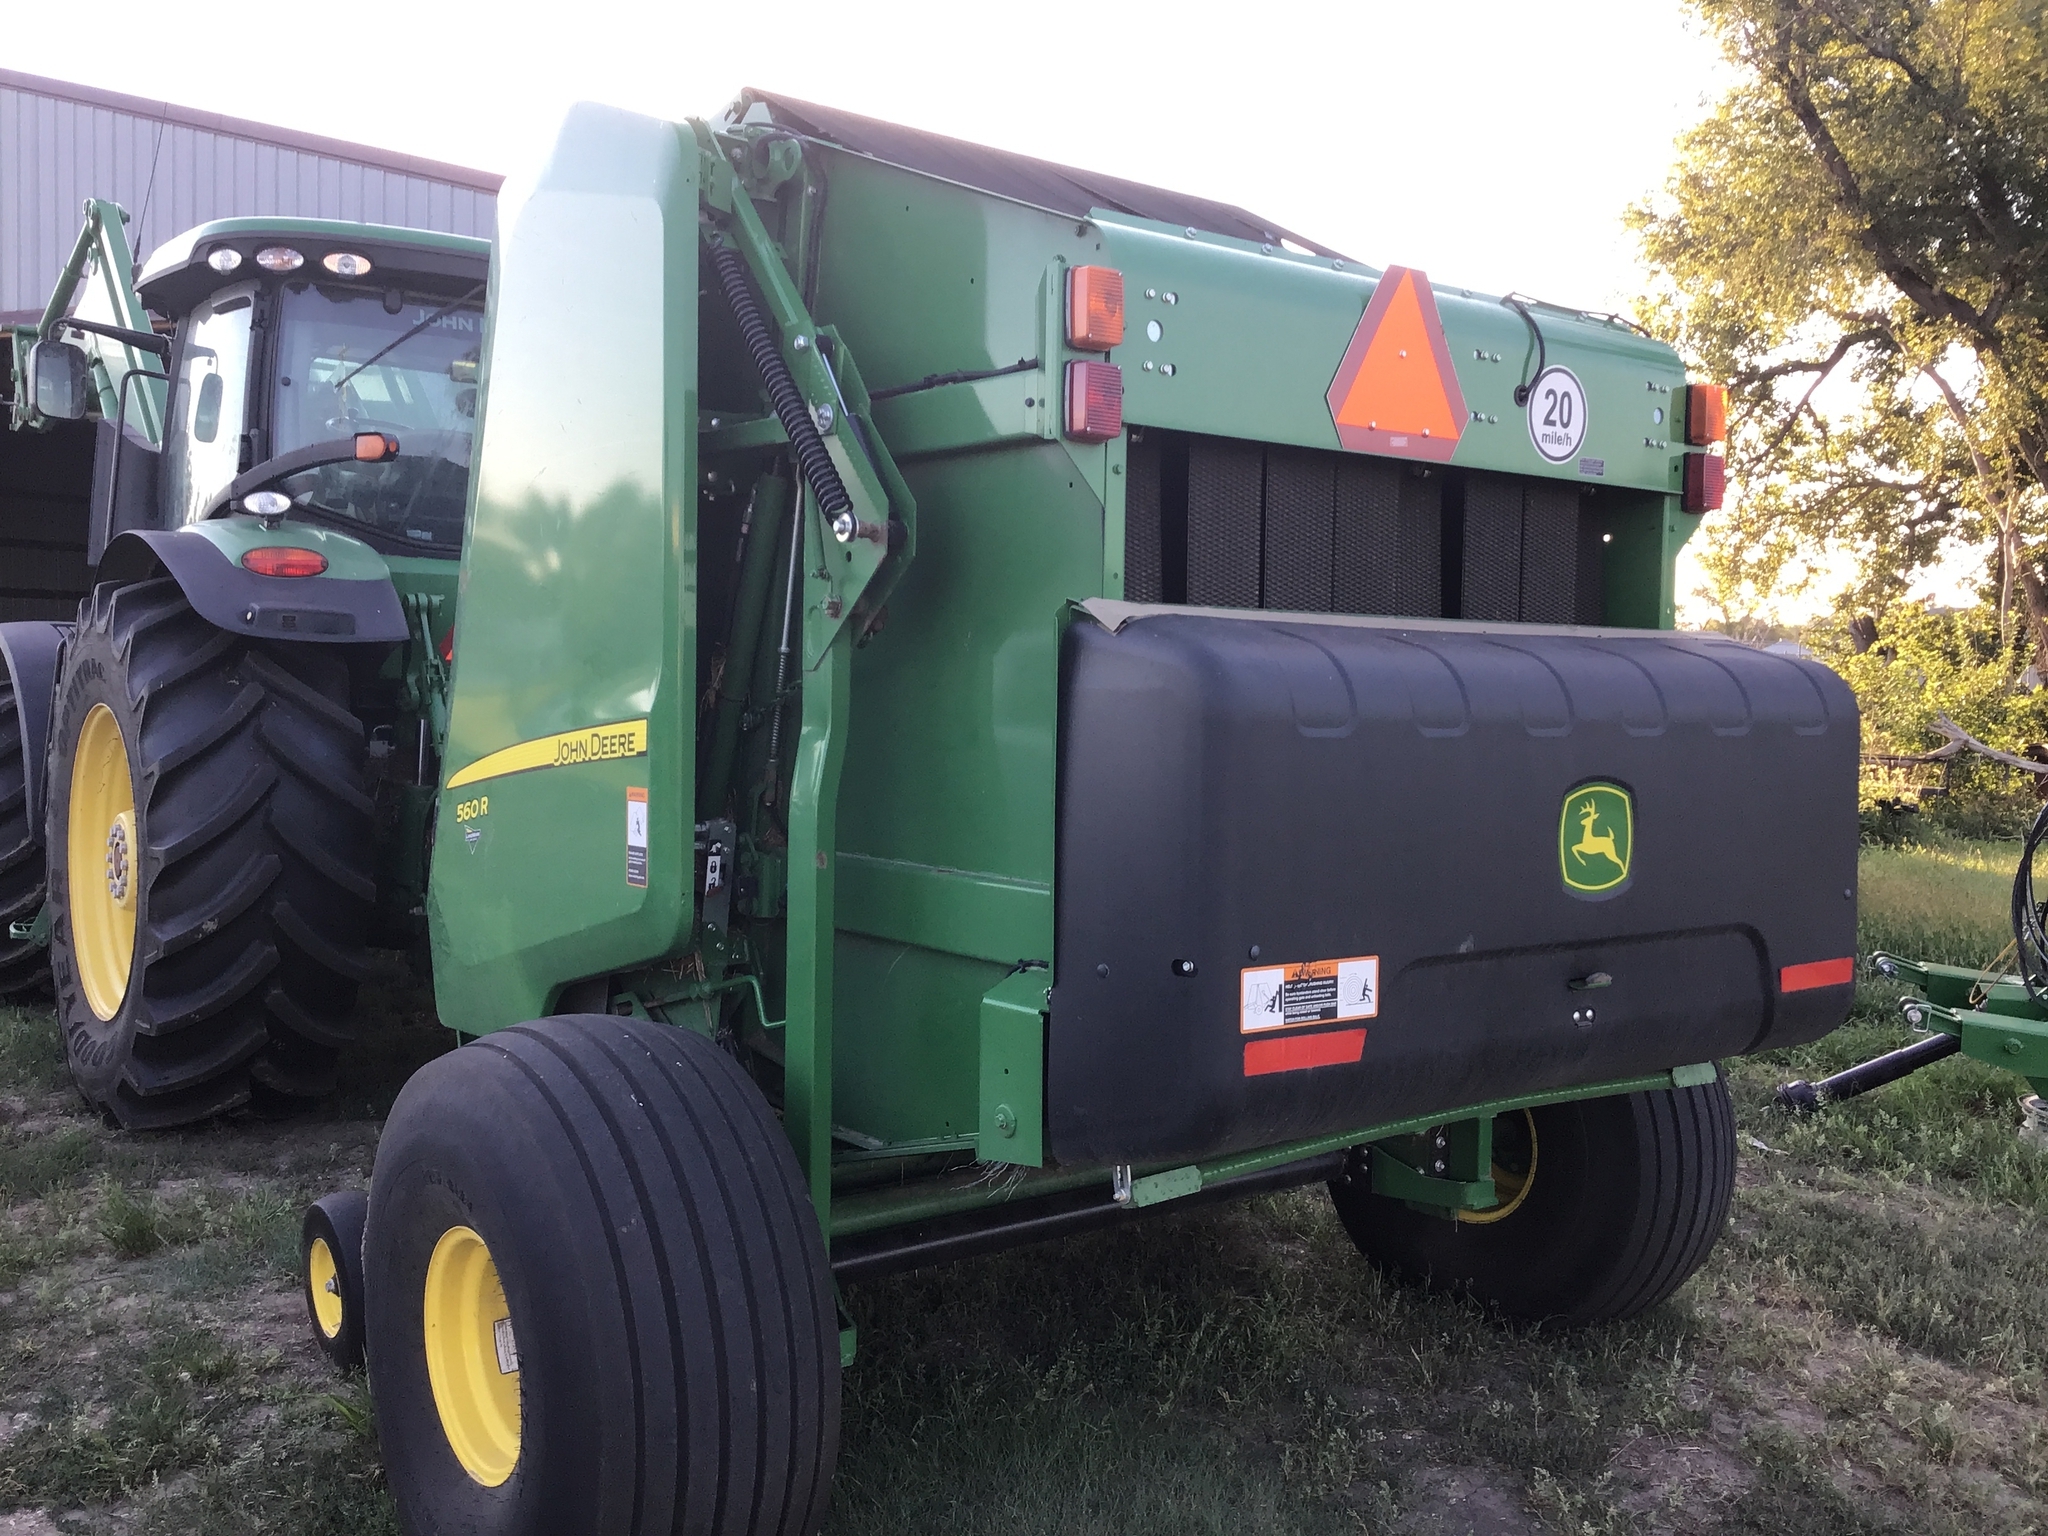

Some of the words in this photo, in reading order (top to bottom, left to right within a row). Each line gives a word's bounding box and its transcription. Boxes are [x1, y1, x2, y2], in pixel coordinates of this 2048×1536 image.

[1543, 387, 1573, 429] 20
[1541, 431, 1572, 447] mile/h
[553, 737, 588, 763] JOHN
[590, 732, 636, 758] DEERE
